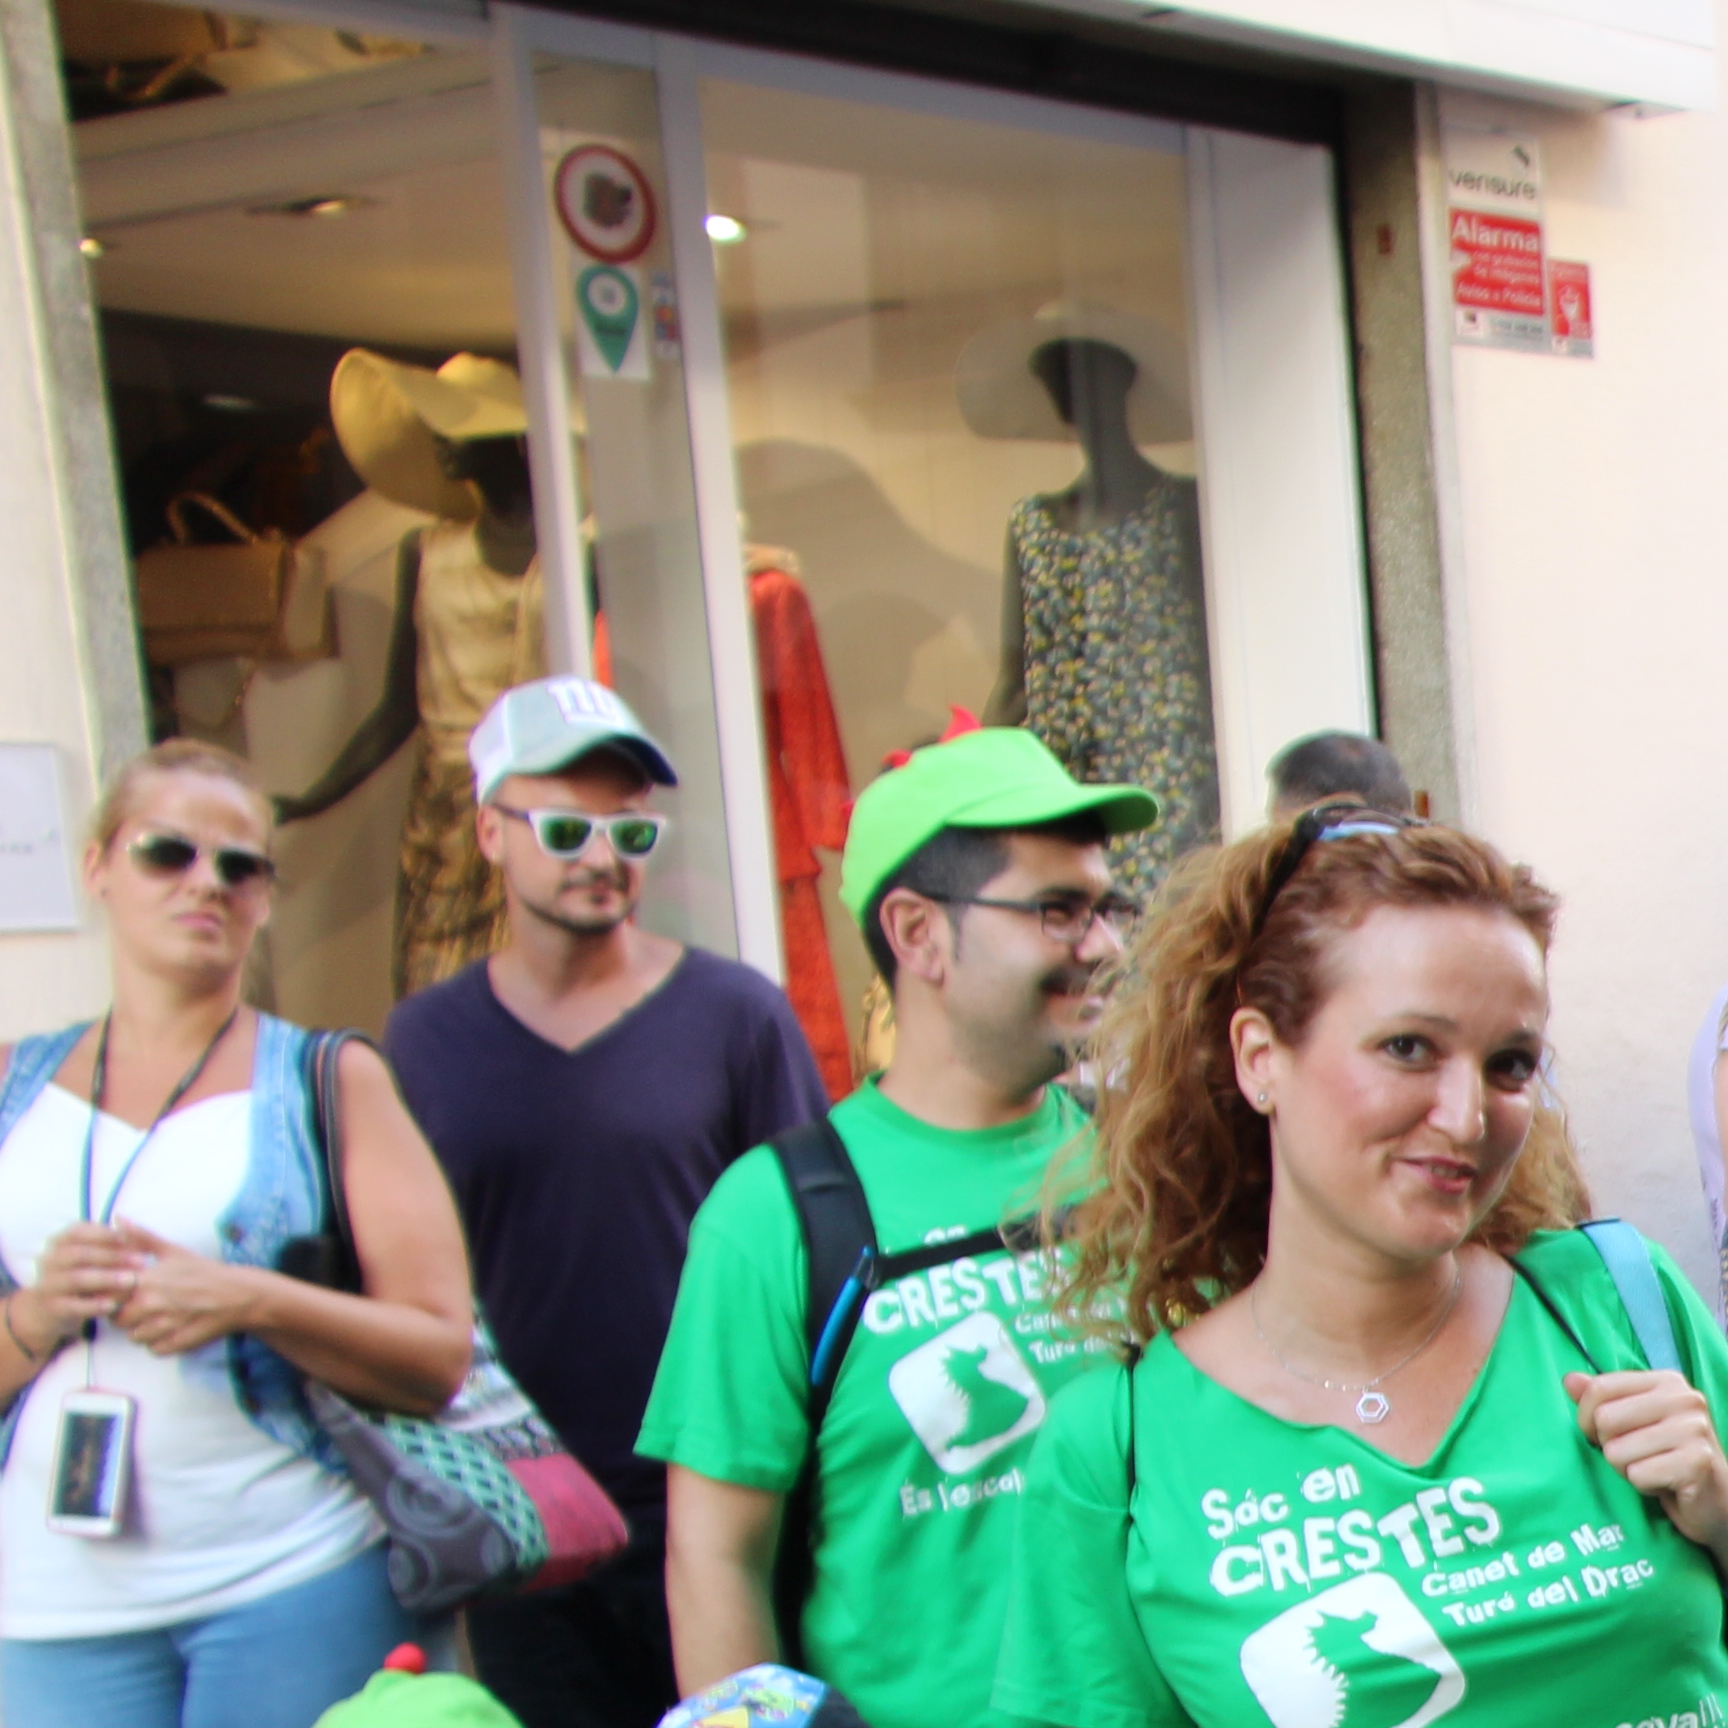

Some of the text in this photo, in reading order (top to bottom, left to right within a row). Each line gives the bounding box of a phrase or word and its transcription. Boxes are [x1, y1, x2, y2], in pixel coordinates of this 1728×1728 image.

[1453, 215, 1538, 251] Alarma
[1201, 1464, 1361, 1540] Sóc en
[1209, 1477, 1502, 1596] CRESTES
[1420, 1522, 1626, 1597] Canet de Mar
[1441, 1556, 1656, 1628] Turó del Drac
